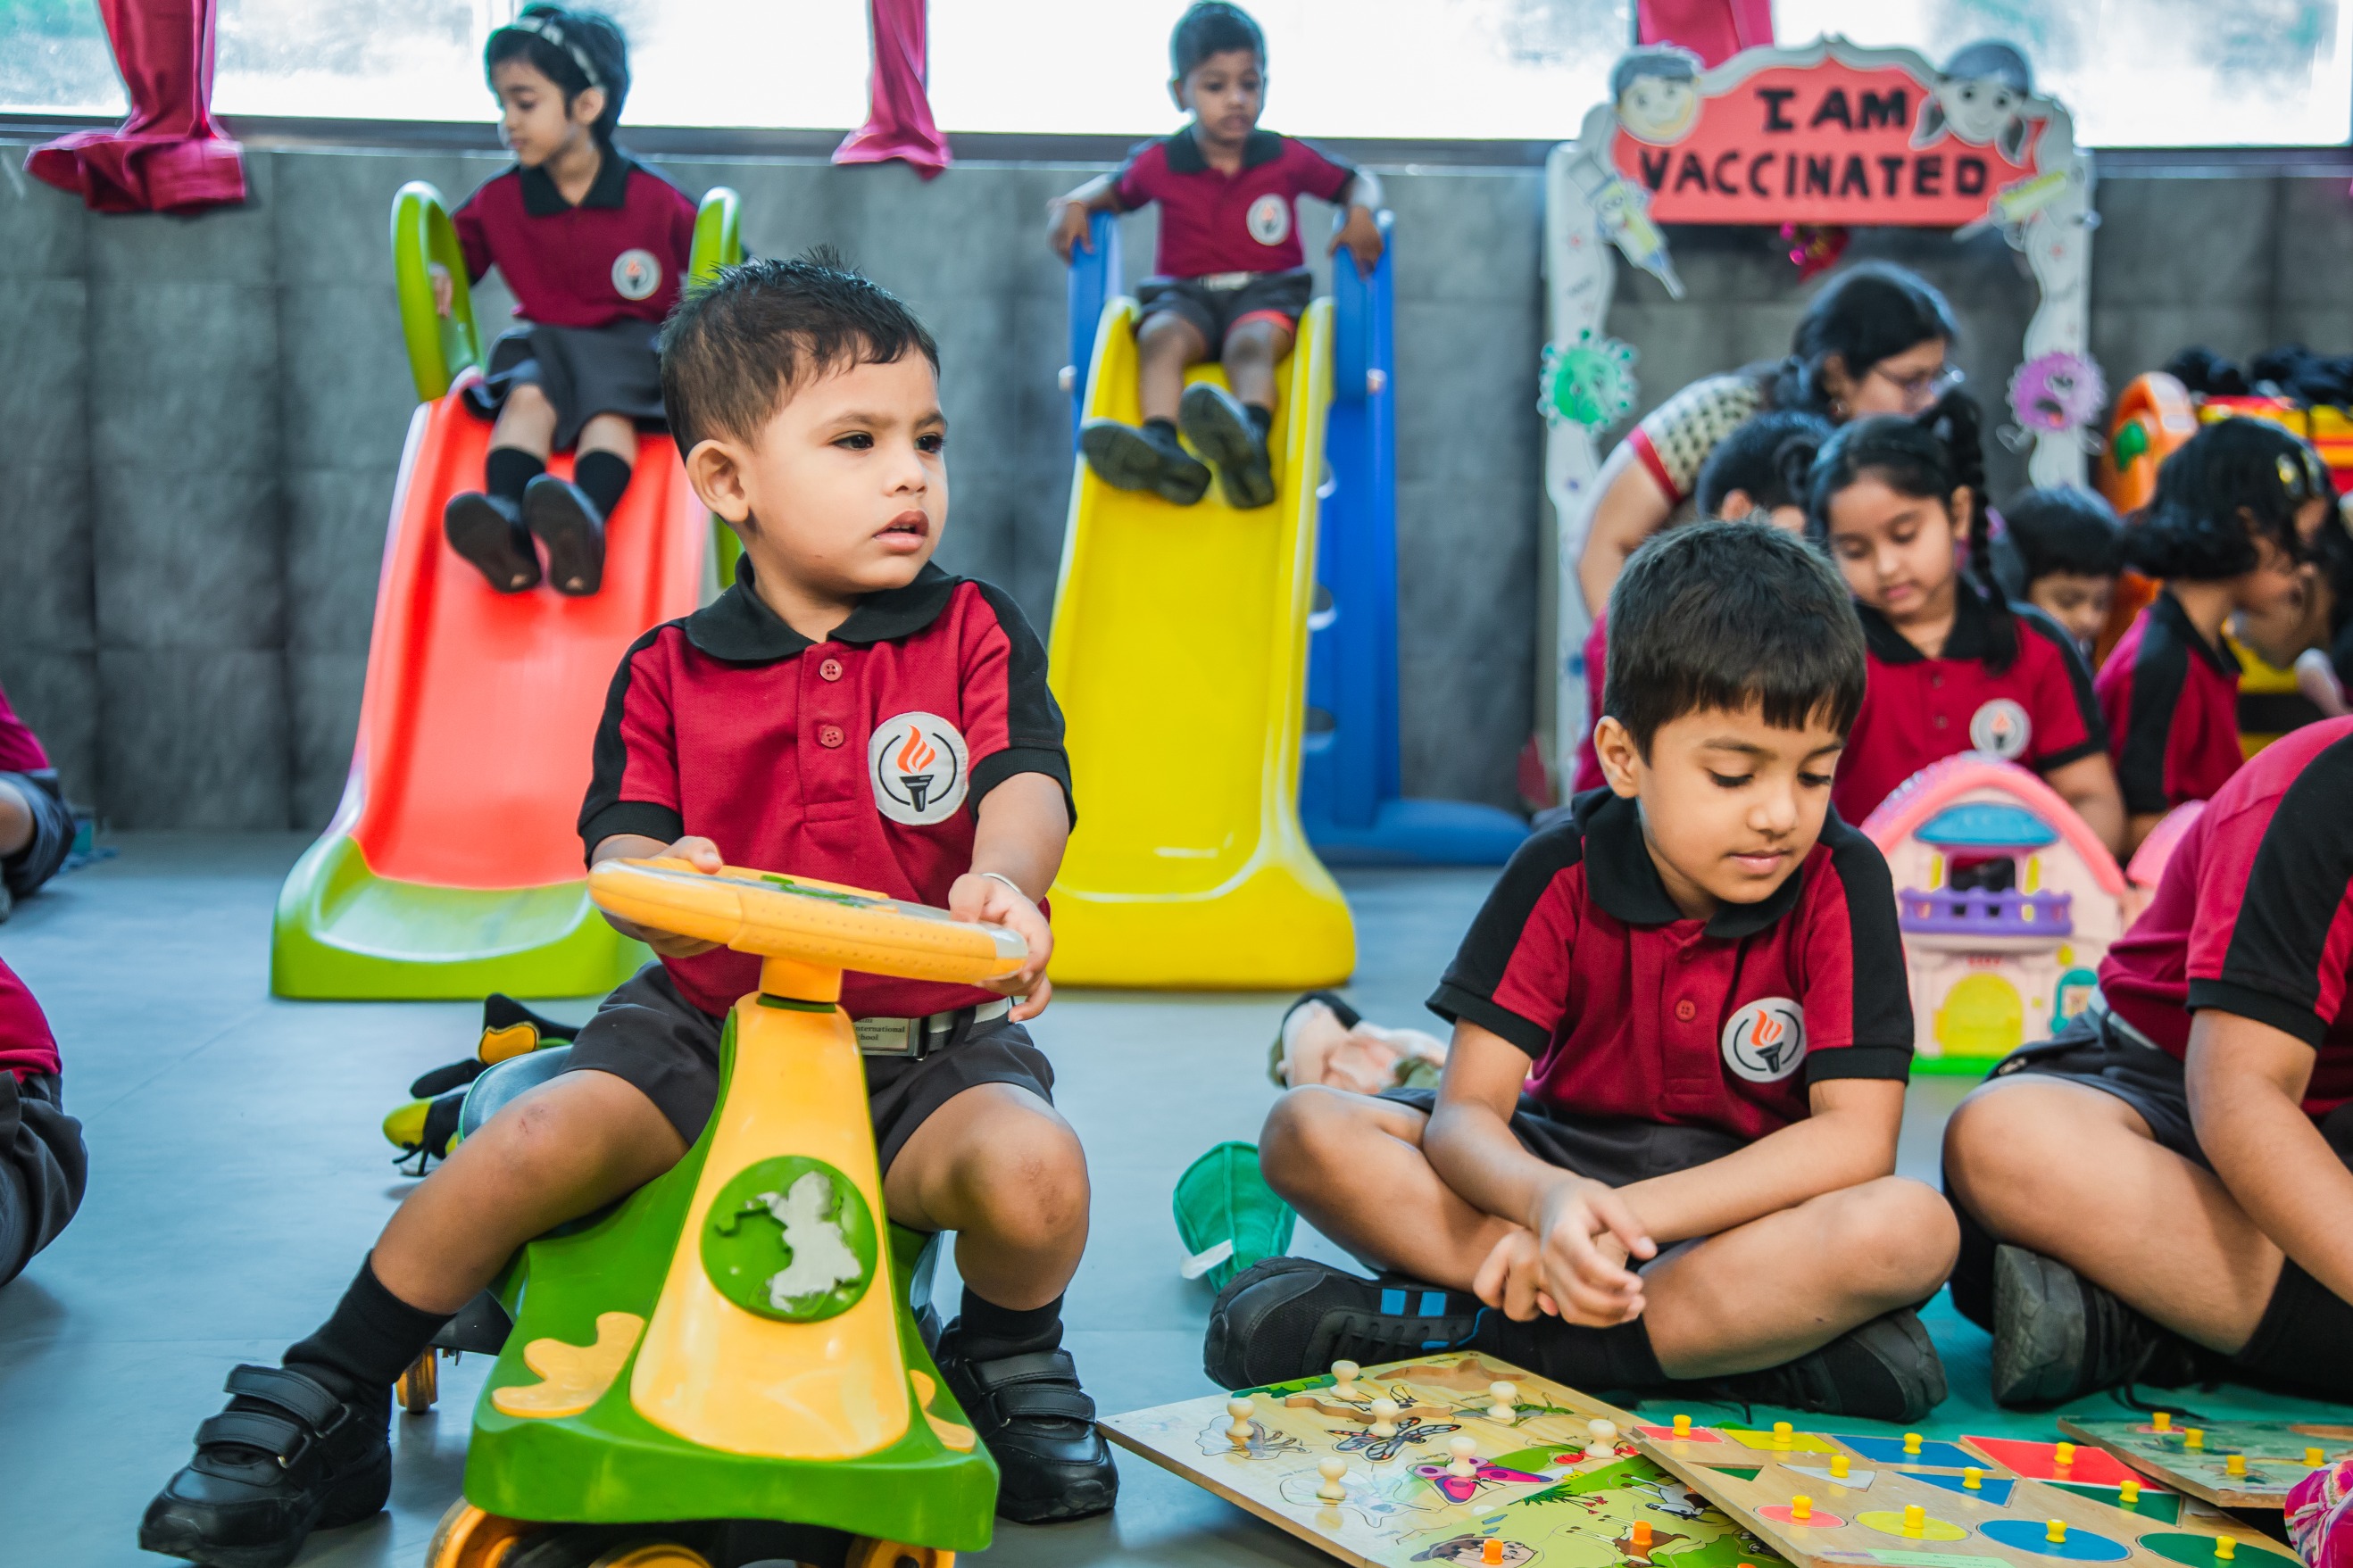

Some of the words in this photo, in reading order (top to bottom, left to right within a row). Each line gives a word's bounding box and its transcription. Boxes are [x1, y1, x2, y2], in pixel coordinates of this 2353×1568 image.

[1756, 87, 1796, 133] I
[1810, 87, 1907, 129] AM
[1639, 149, 1986, 197] VACCINATED
